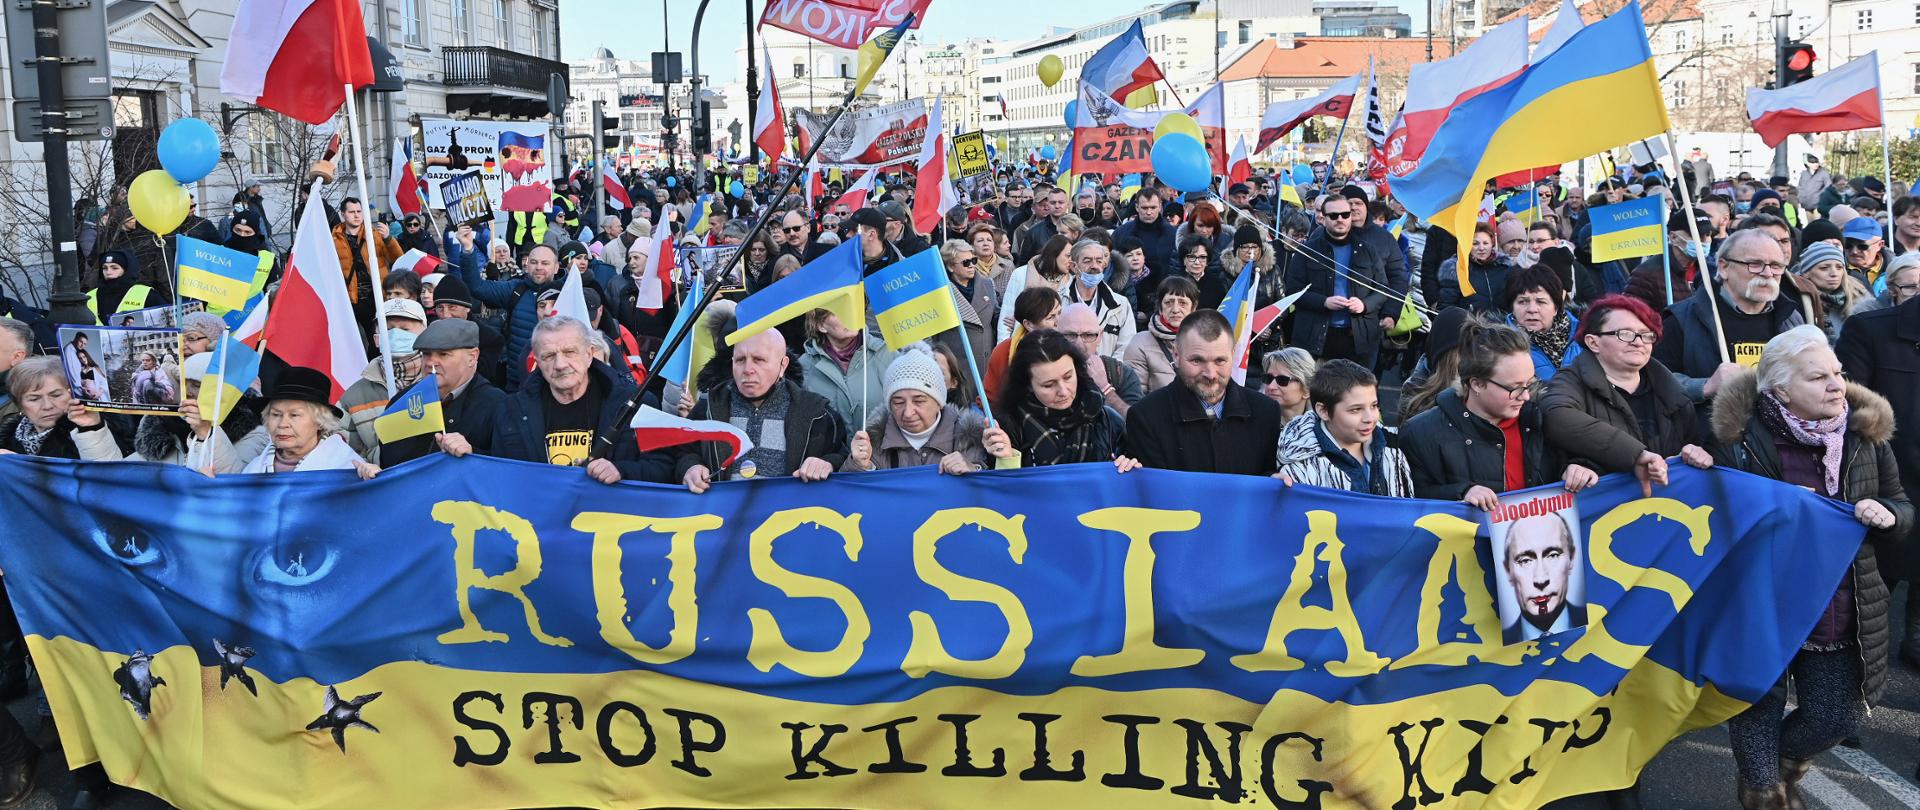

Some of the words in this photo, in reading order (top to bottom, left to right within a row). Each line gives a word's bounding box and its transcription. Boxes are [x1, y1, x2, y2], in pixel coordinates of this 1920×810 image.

[427, 146, 446, 154] GAZ
[955, 133, 981, 145] ACHTUNG
[1082, 138, 1152, 162] CZAN
[442, 175, 480, 205] UKRAINO
[448, 196, 489, 224] WALCZ!
[1612, 207, 1649, 222] WOLNA
[1610, 236, 1658, 251] UKRAINA
[194, 248, 233, 268] WOLNA
[182, 275, 227, 297] UKRAINA
[882, 270, 921, 294] WOLNA
[894, 307, 940, 335] UKRAINA
[547, 434, 588, 447] CHTUNG
[1490, 492, 1574, 524] Bloodymir
[452, 690, 727, 778] STOP
[781, 711, 1334, 810] KILLING
